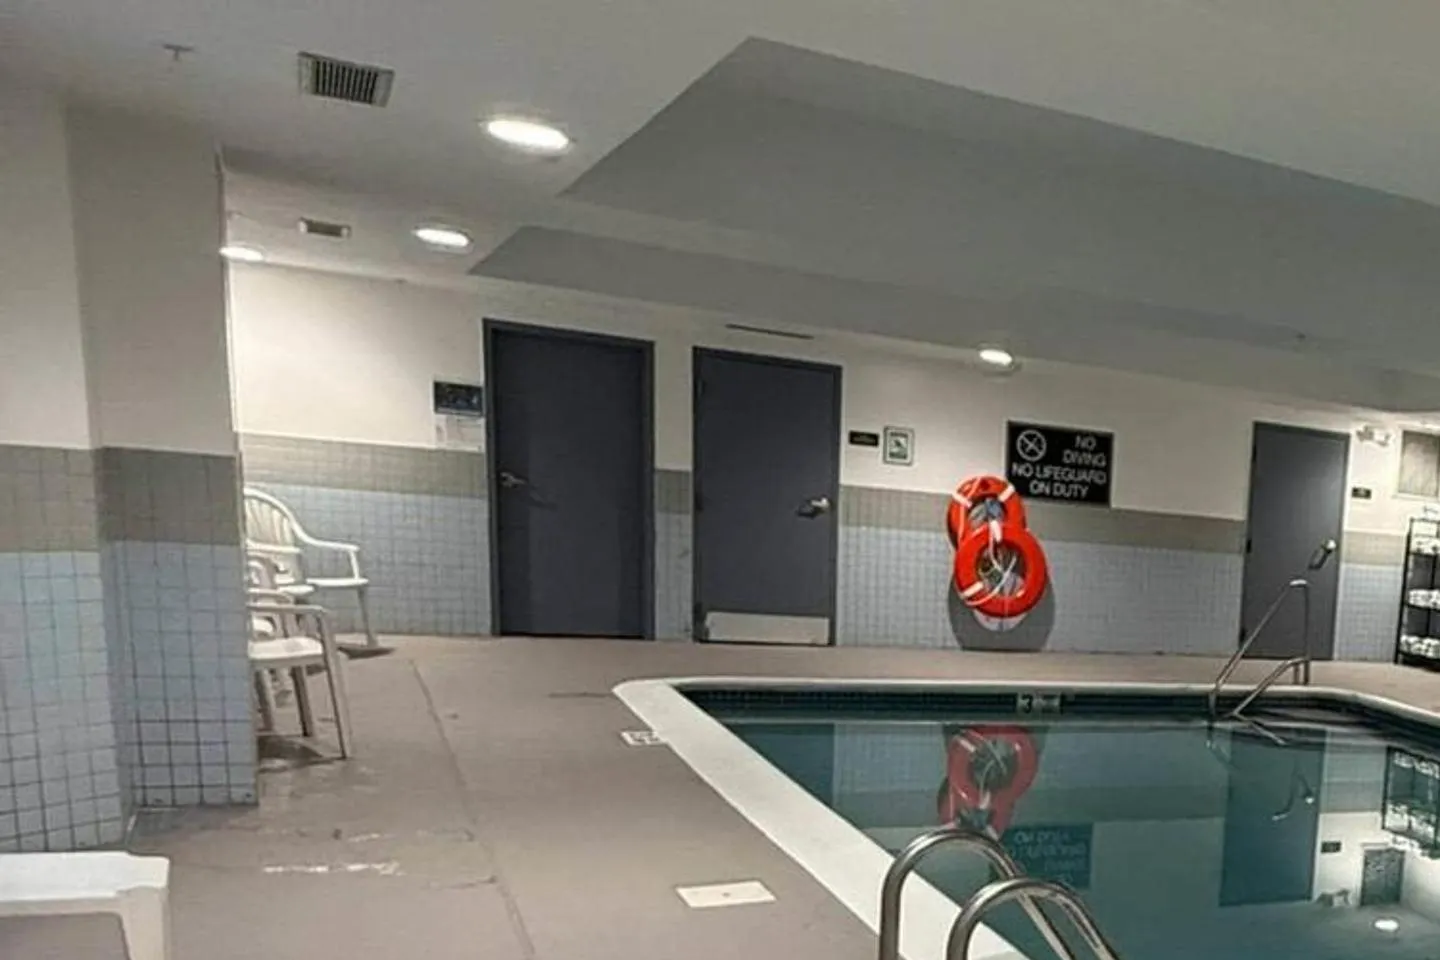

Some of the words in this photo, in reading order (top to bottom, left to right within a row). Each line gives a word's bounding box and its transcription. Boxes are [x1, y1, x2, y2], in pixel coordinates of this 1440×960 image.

[1075, 435, 1097, 451] NO
[1062, 449, 1106, 468] DIVING
[1011, 462, 1034, 478] NO
[1035, 464, 1106, 486] LIFEGUARD
[1029, 479, 1051, 496] ON
[1052, 482, 1089, 499] DUTY
